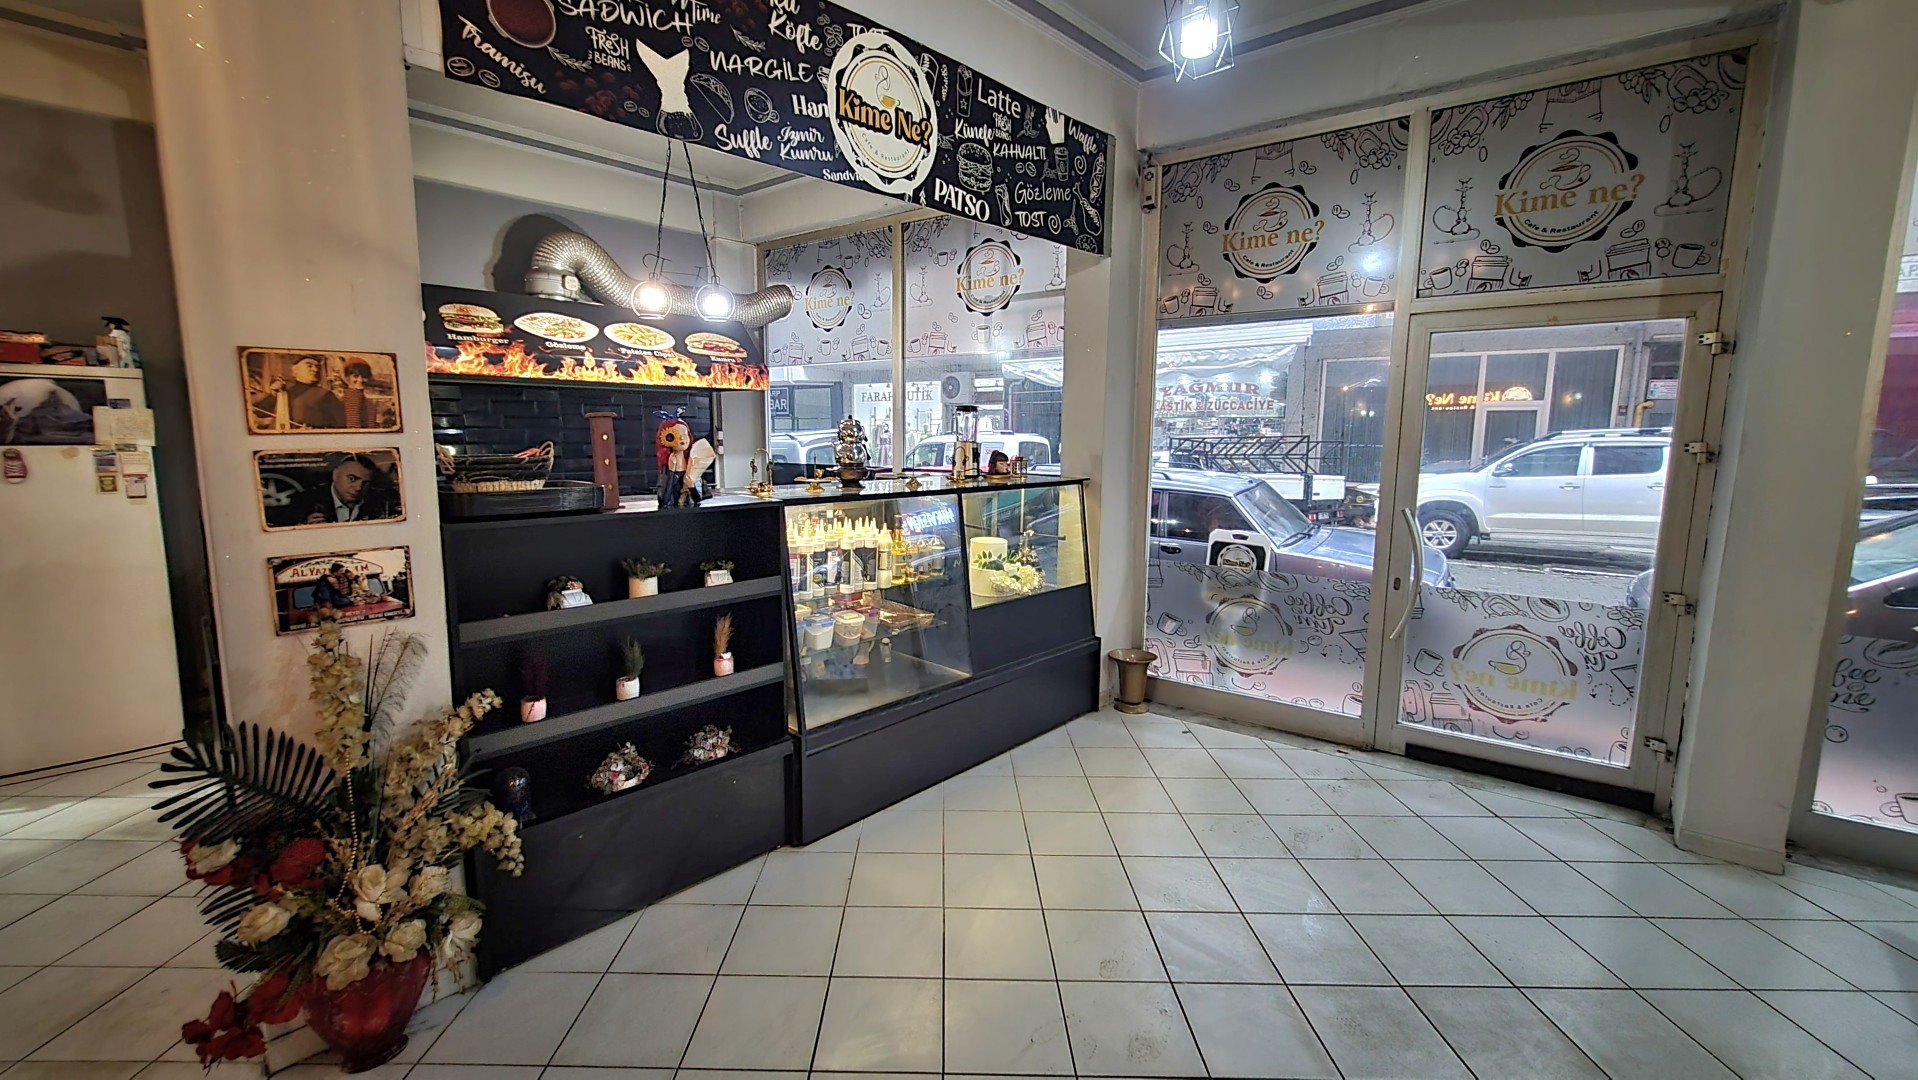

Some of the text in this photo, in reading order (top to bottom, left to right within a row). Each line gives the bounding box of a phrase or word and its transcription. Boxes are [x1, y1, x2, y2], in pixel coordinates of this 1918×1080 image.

[690, 0, 721, 24] Time
[768, 9, 823, 54] Köfte
[457, 14, 547, 95] Tramisu
[594, 51, 627, 72] BEANS
[709, 50, 814, 83] NARGİLE
[977, 78, 1022, 119] Latte
[838, 87, 933, 146] Kime Ne?
[714, 123, 773, 159] Suffle
[954, 118, 995, 147] Künefe
[1068, 119, 1098, 155] Waffle
[779, 142, 834, 162] Kumru
[993, 142, 1047, 161] KAHVALTI
[934, 177, 990, 222] PATSO
[1014, 181, 1072, 205] Gözleme
[1495, 173, 1646, 217] Kime ne?
[1014, 211, 1047, 228] TOST
[1524, 218, 1540, 232] Cafe
[1549, 210, 1600, 234] Restaurant
[1222, 219, 1325, 252] Kime ne?
[1242, 254, 1254, 266] Cafe
[1260, 249, 1295, 268] Restaurant
[955, 267, 1025, 292] Kime ne?
[804, 290, 855, 311] Kime ne?
[447, 333, 510, 344] Hamburger
[907, 388, 934, 401] UTİK
[1160, 379, 1260, 398] YAĞMUR
[1196, 401, 1204, 411] &
[1207, 398, 1275, 411] ZÜCCACİYE
[290, 567, 307, 578] AL
